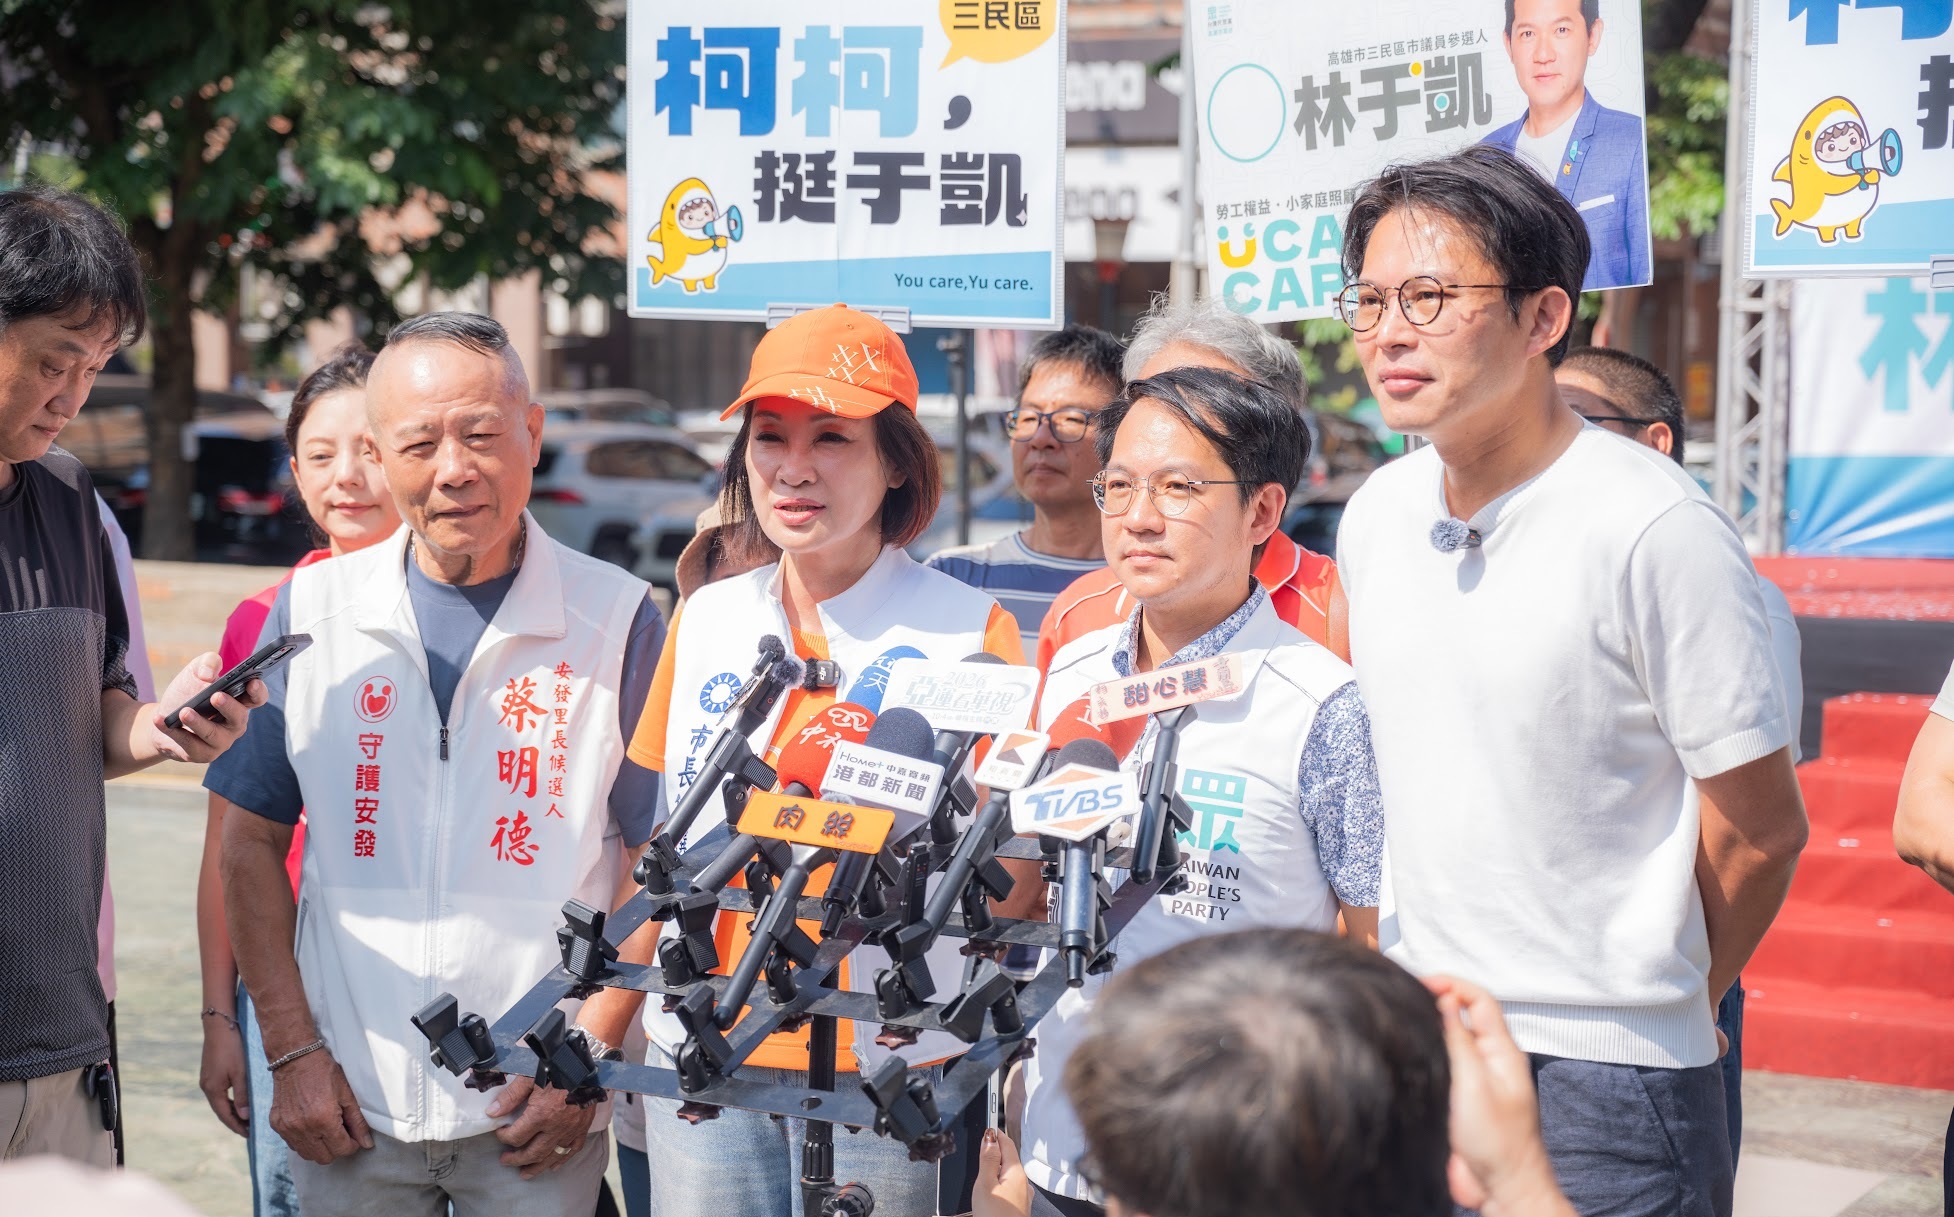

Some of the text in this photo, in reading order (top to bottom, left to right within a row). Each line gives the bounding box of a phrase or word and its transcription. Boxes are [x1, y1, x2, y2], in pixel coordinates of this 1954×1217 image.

[954, 2, 1040, 30] 三民區
[1327, 28, 1488, 67] 高雄市三民區市議員參選人
[1294, 52, 1492, 150] 林于凱
[753, 150, 1028, 227] 挺于凱
[894, 273, 924, 289] You
[994, 276, 1033, 291] care.
[1123, 667, 1208, 708] 甜心慧
[545, 661, 574, 820] 安發里長候選人
[490, 675, 548, 867] 蔡明德
[833, 764, 926, 801] 港都新聞
[354, 732, 384, 858] 守護安發
[1024, 784, 1123, 822] TVBS
[773, 803, 854, 838] 肉絲
[1179, 860, 1240, 881] AIWAN
[1171, 899, 1230, 921] PARTY
[1184, 880, 1241, 902] OPLE'S
